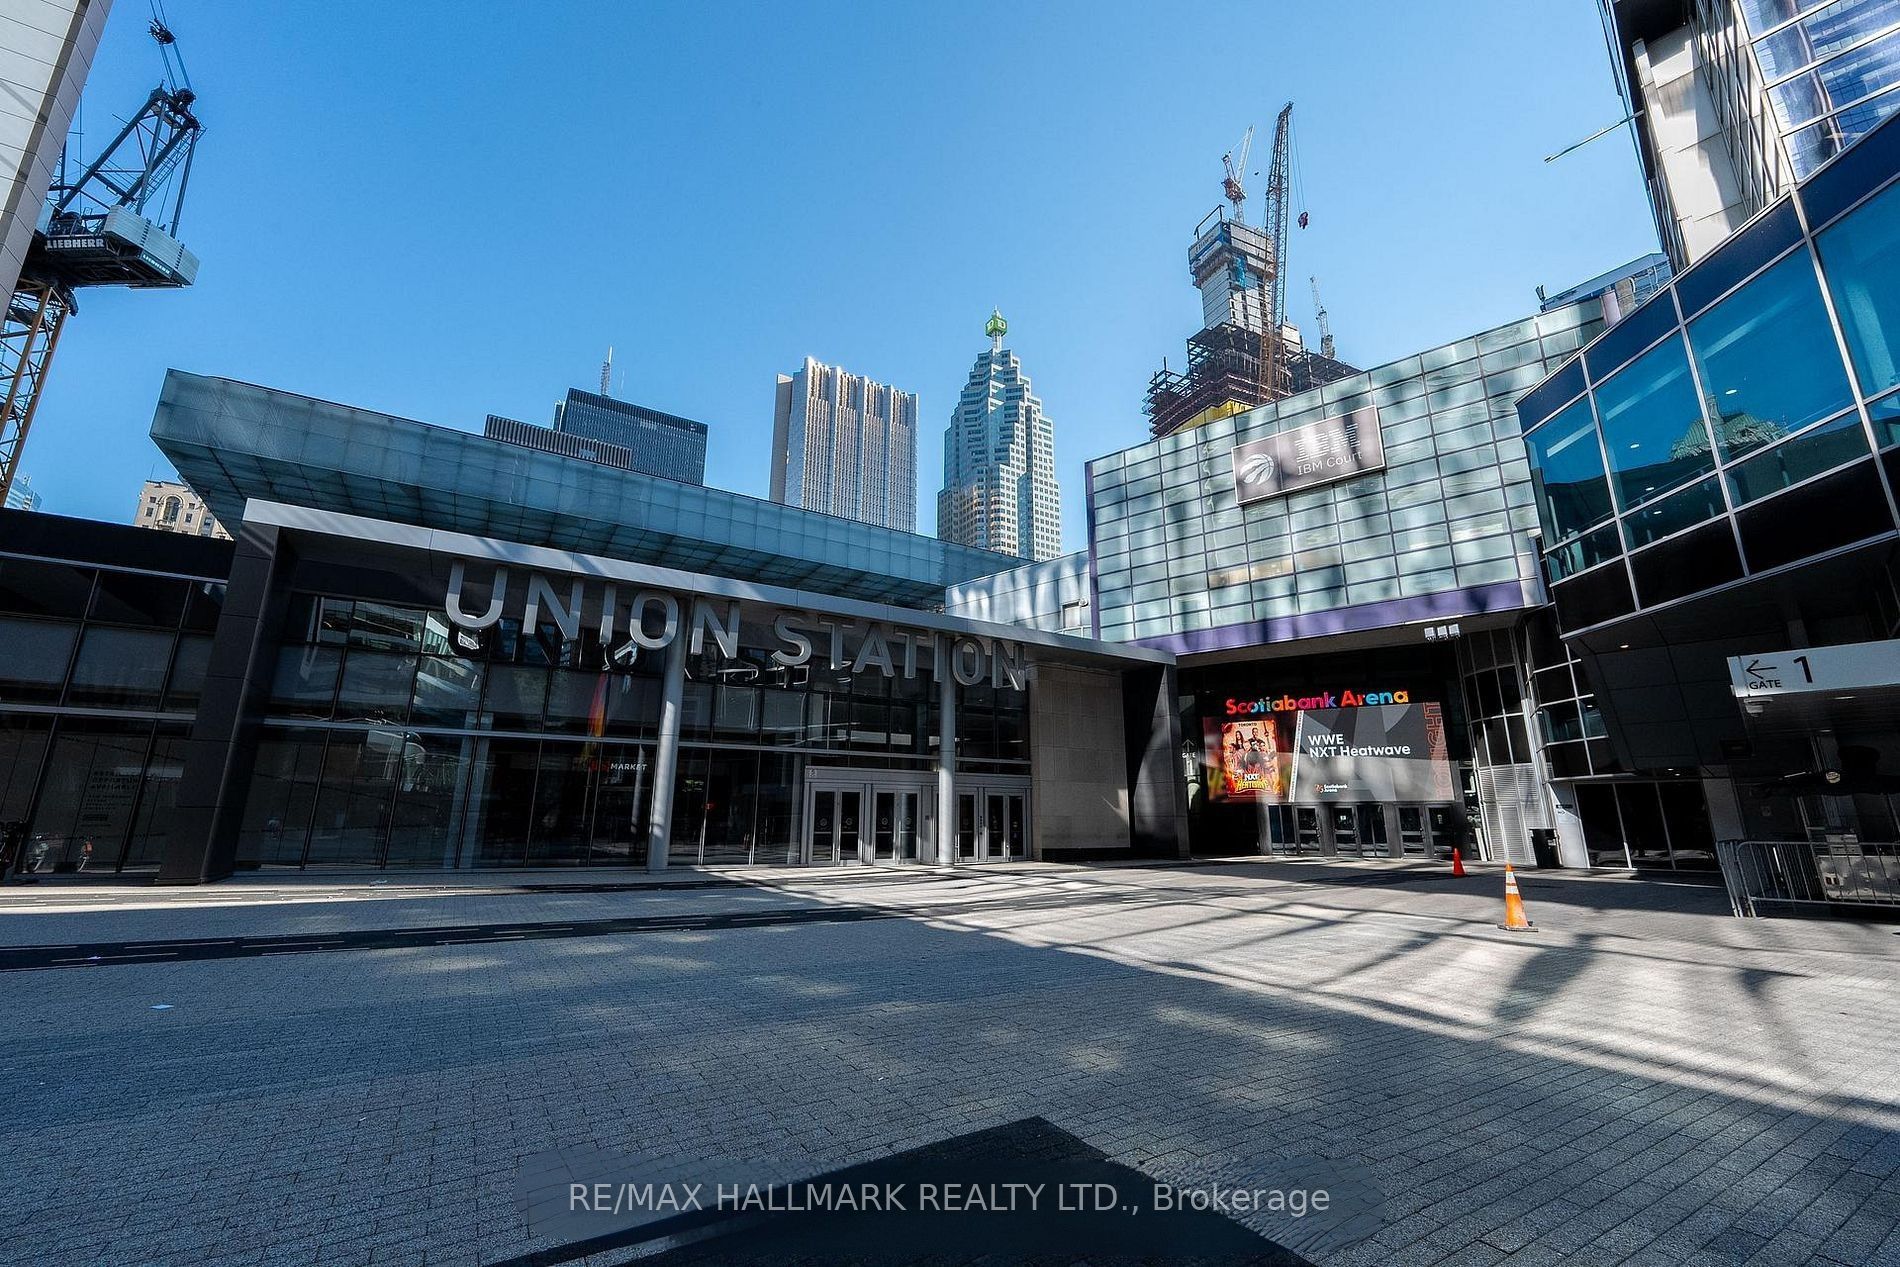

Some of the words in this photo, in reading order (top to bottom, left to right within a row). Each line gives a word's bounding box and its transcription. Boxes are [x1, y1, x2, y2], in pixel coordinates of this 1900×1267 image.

[46, 239, 104, 248] LIEBHERR
[1298, 462, 1323, 476] IBM
[1326, 450, 1362, 468] Court
[445, 558, 742, 659] UNION
[771, 613, 1026, 692] STATION
[1749, 680, 1781, 689] GATE
[1793, 656, 1813, 683] 1
[1225, 691, 1338, 715] Scotiabank
[1341, 690, 1409, 707] Arena
[1307, 734, 1345, 746] WWE
[1309, 746, 1337, 758] NXT
[1339, 744, 1411, 757] Heatwave
[611, 763, 648, 772] MARKET
